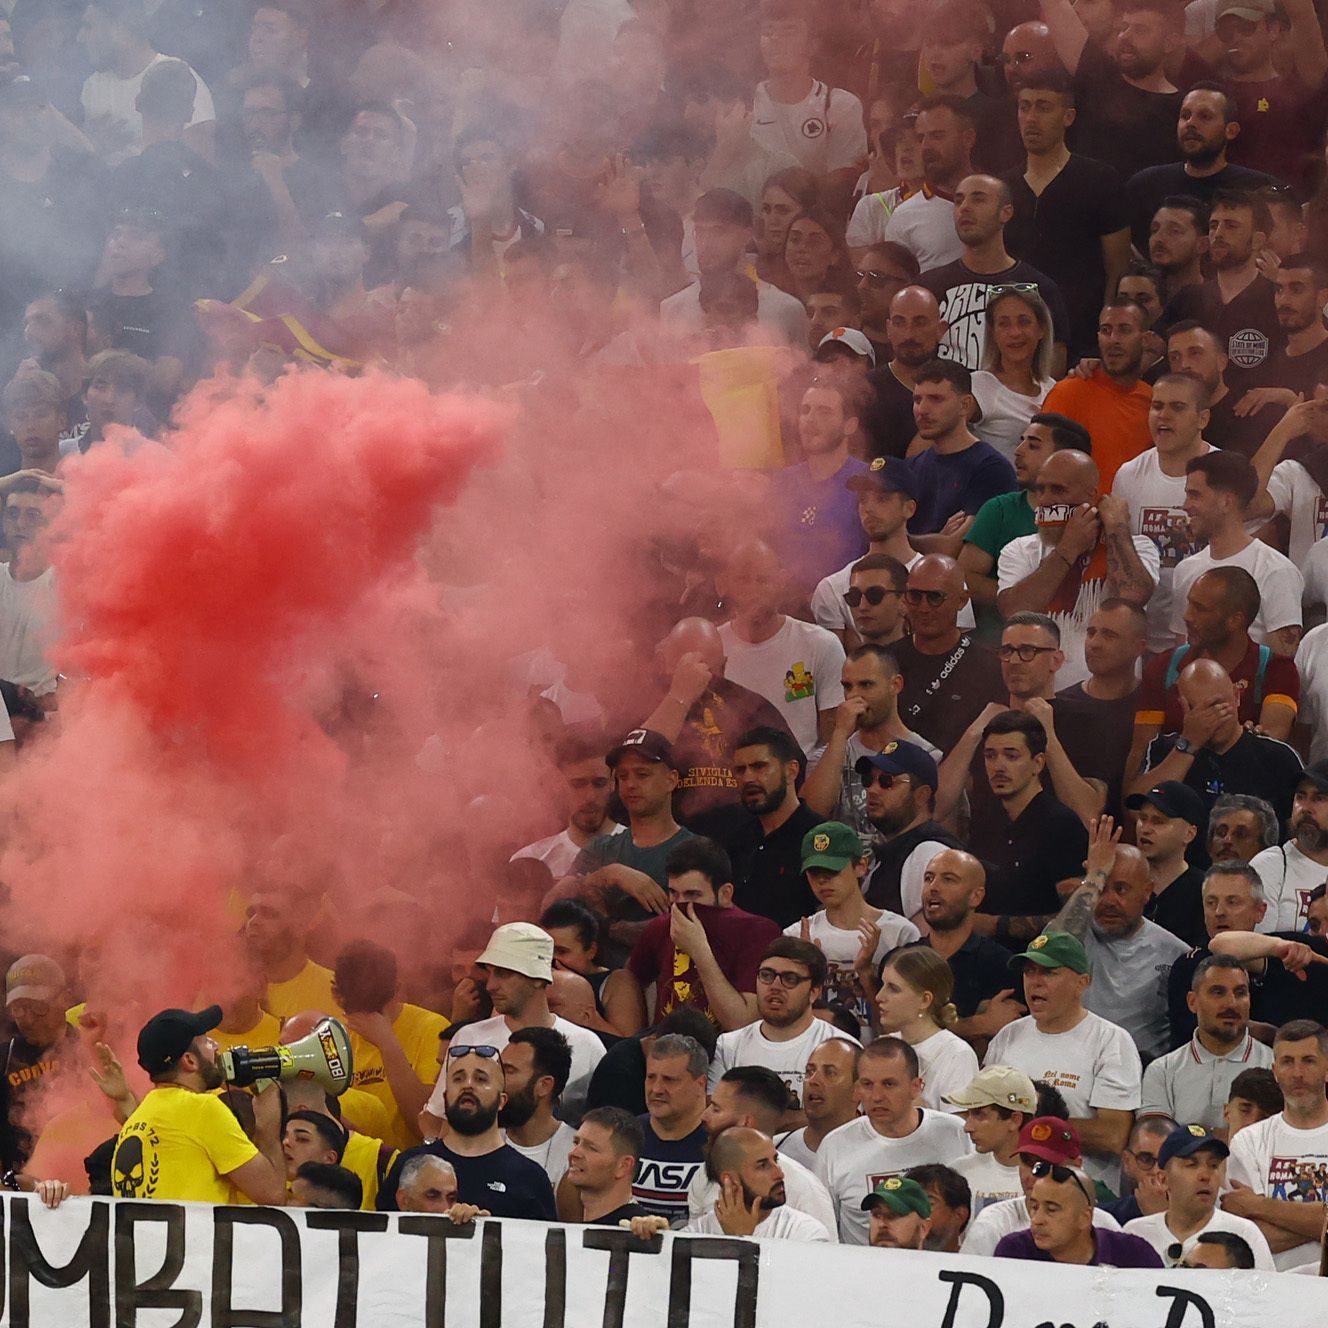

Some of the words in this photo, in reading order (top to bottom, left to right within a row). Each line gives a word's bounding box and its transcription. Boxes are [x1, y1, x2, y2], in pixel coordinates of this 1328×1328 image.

[940, 647, 965, 680] adidas
[688, 767, 733, 779] SIVIGLIA
[1060, 1072, 1081, 1083] nome
